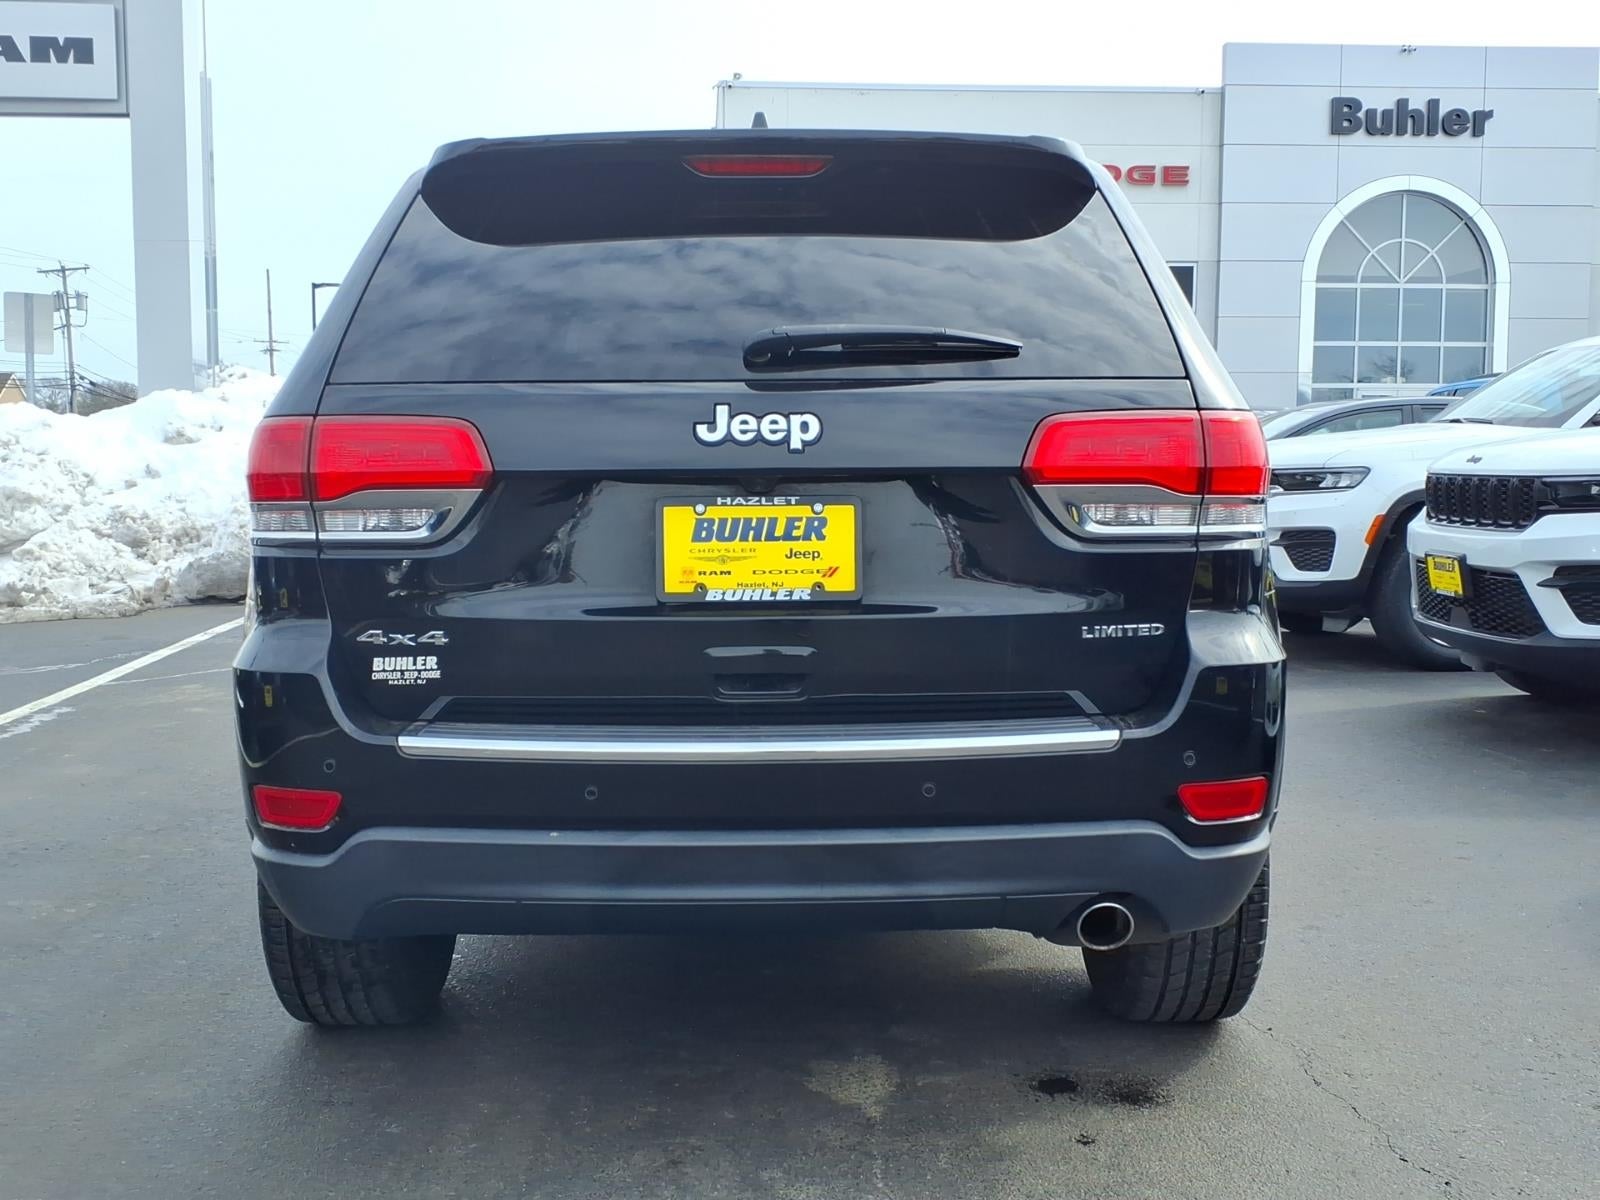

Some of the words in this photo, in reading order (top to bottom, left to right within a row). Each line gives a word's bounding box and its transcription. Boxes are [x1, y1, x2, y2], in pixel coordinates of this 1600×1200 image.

[1330, 96, 1494, 138] Buhler
[693, 403, 823, 454] Jeep
[717, 496, 800, 505] HAZLET
[691, 516, 828, 543] BUHLER
[785, 547, 821, 561] Jeep
[705, 588, 811, 601] BUHLER
[1081, 623, 1165, 639] LIMITED
[372, 656, 438, 671] BUHLER
